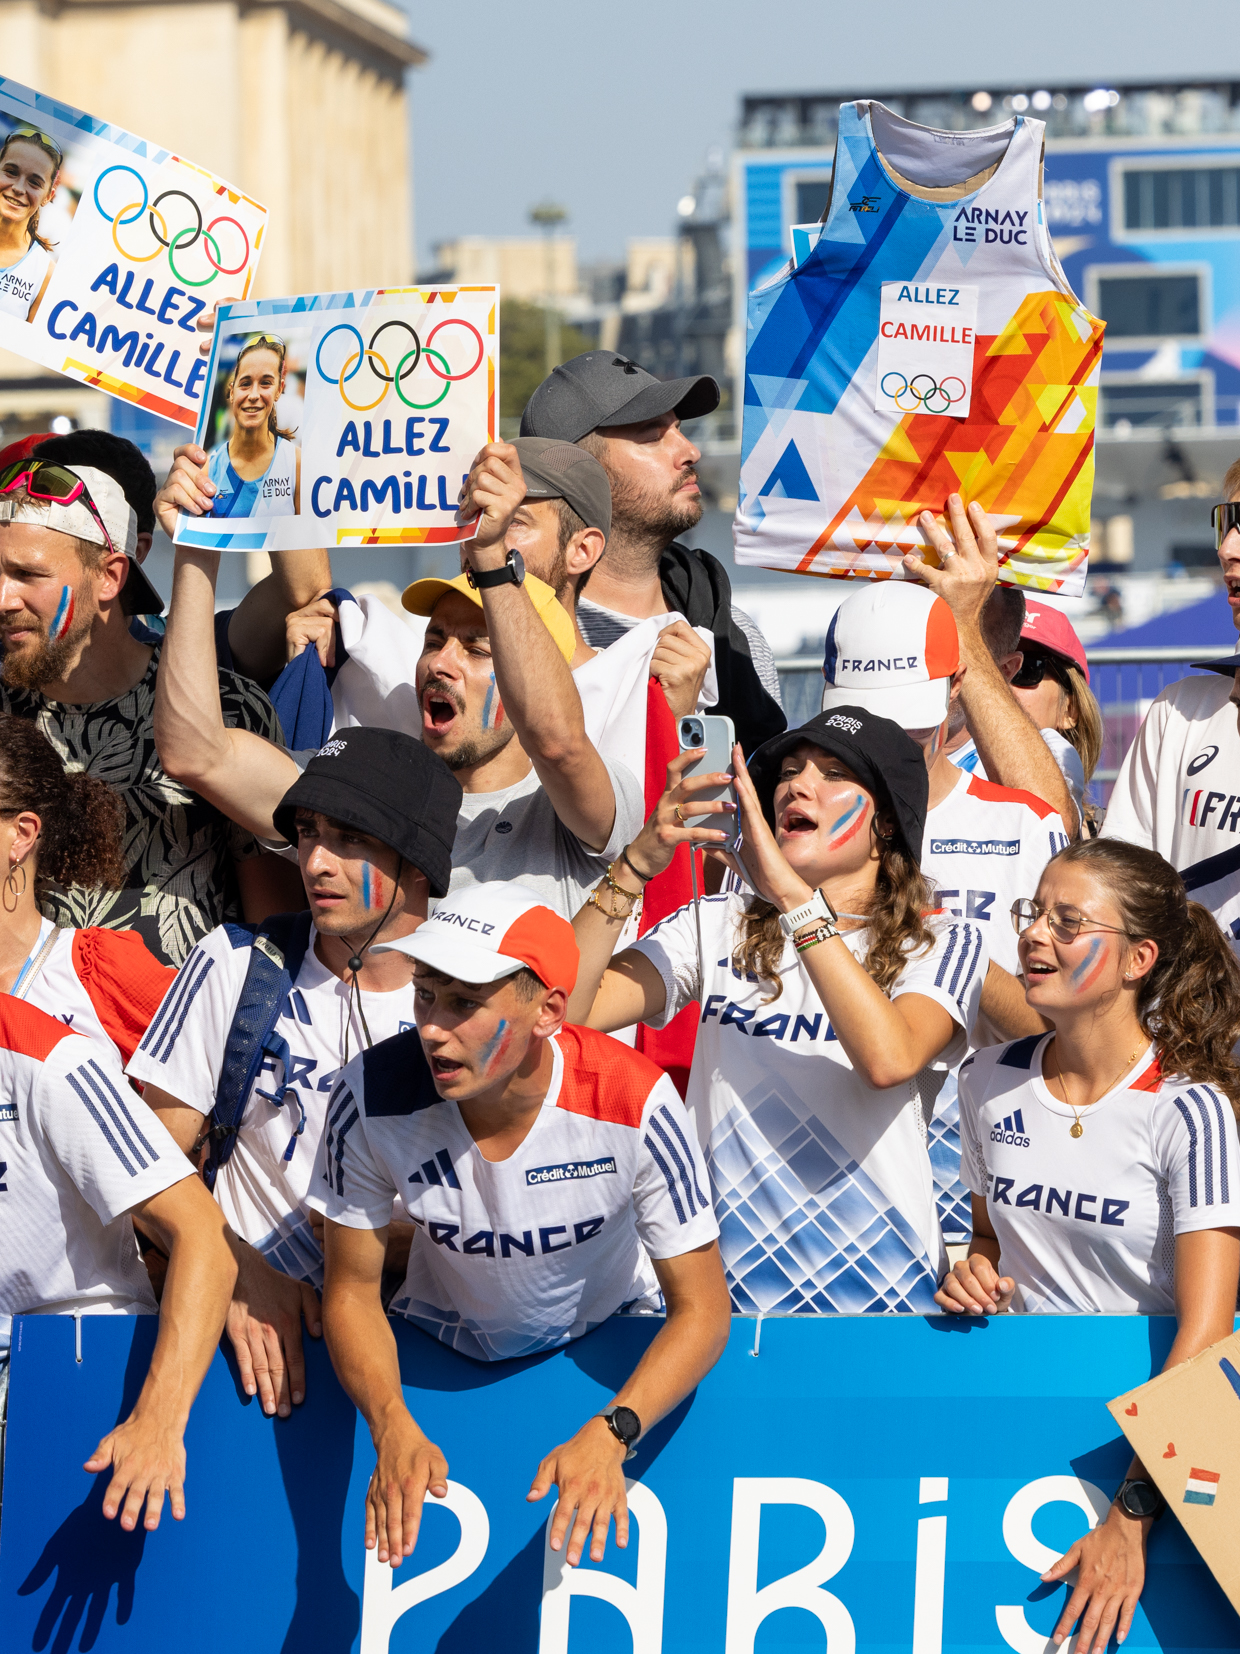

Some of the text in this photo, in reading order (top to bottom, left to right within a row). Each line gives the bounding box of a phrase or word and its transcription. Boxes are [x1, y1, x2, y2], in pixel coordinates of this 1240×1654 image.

[954, 206, 1029, 227] ARNAY
[953, 224, 1028, 246] LE DUC
[0, 273, 34, 291] ARNAY
[11, 286, 32, 302] DUC
[90, 262, 207, 333] ALLEZ
[897, 285, 960, 306] ALLEZ
[880, 321, 973, 345] CAMILLE
[336, 416, 451, 458] ALLEZ
[262, 476, 290, 489] ARNAY
[262, 487, 291, 498] LE DUC
[311, 470, 470, 519] CAMiLL
[841, 656, 918, 672] FRANCE
[932, 842, 1019, 855] Crédit Mutuel
[701, 994, 839, 1042] FRAN
[990, 1129, 1031, 1148] adidas
[527, 1160, 615, 1184] Crédit Mutuel
